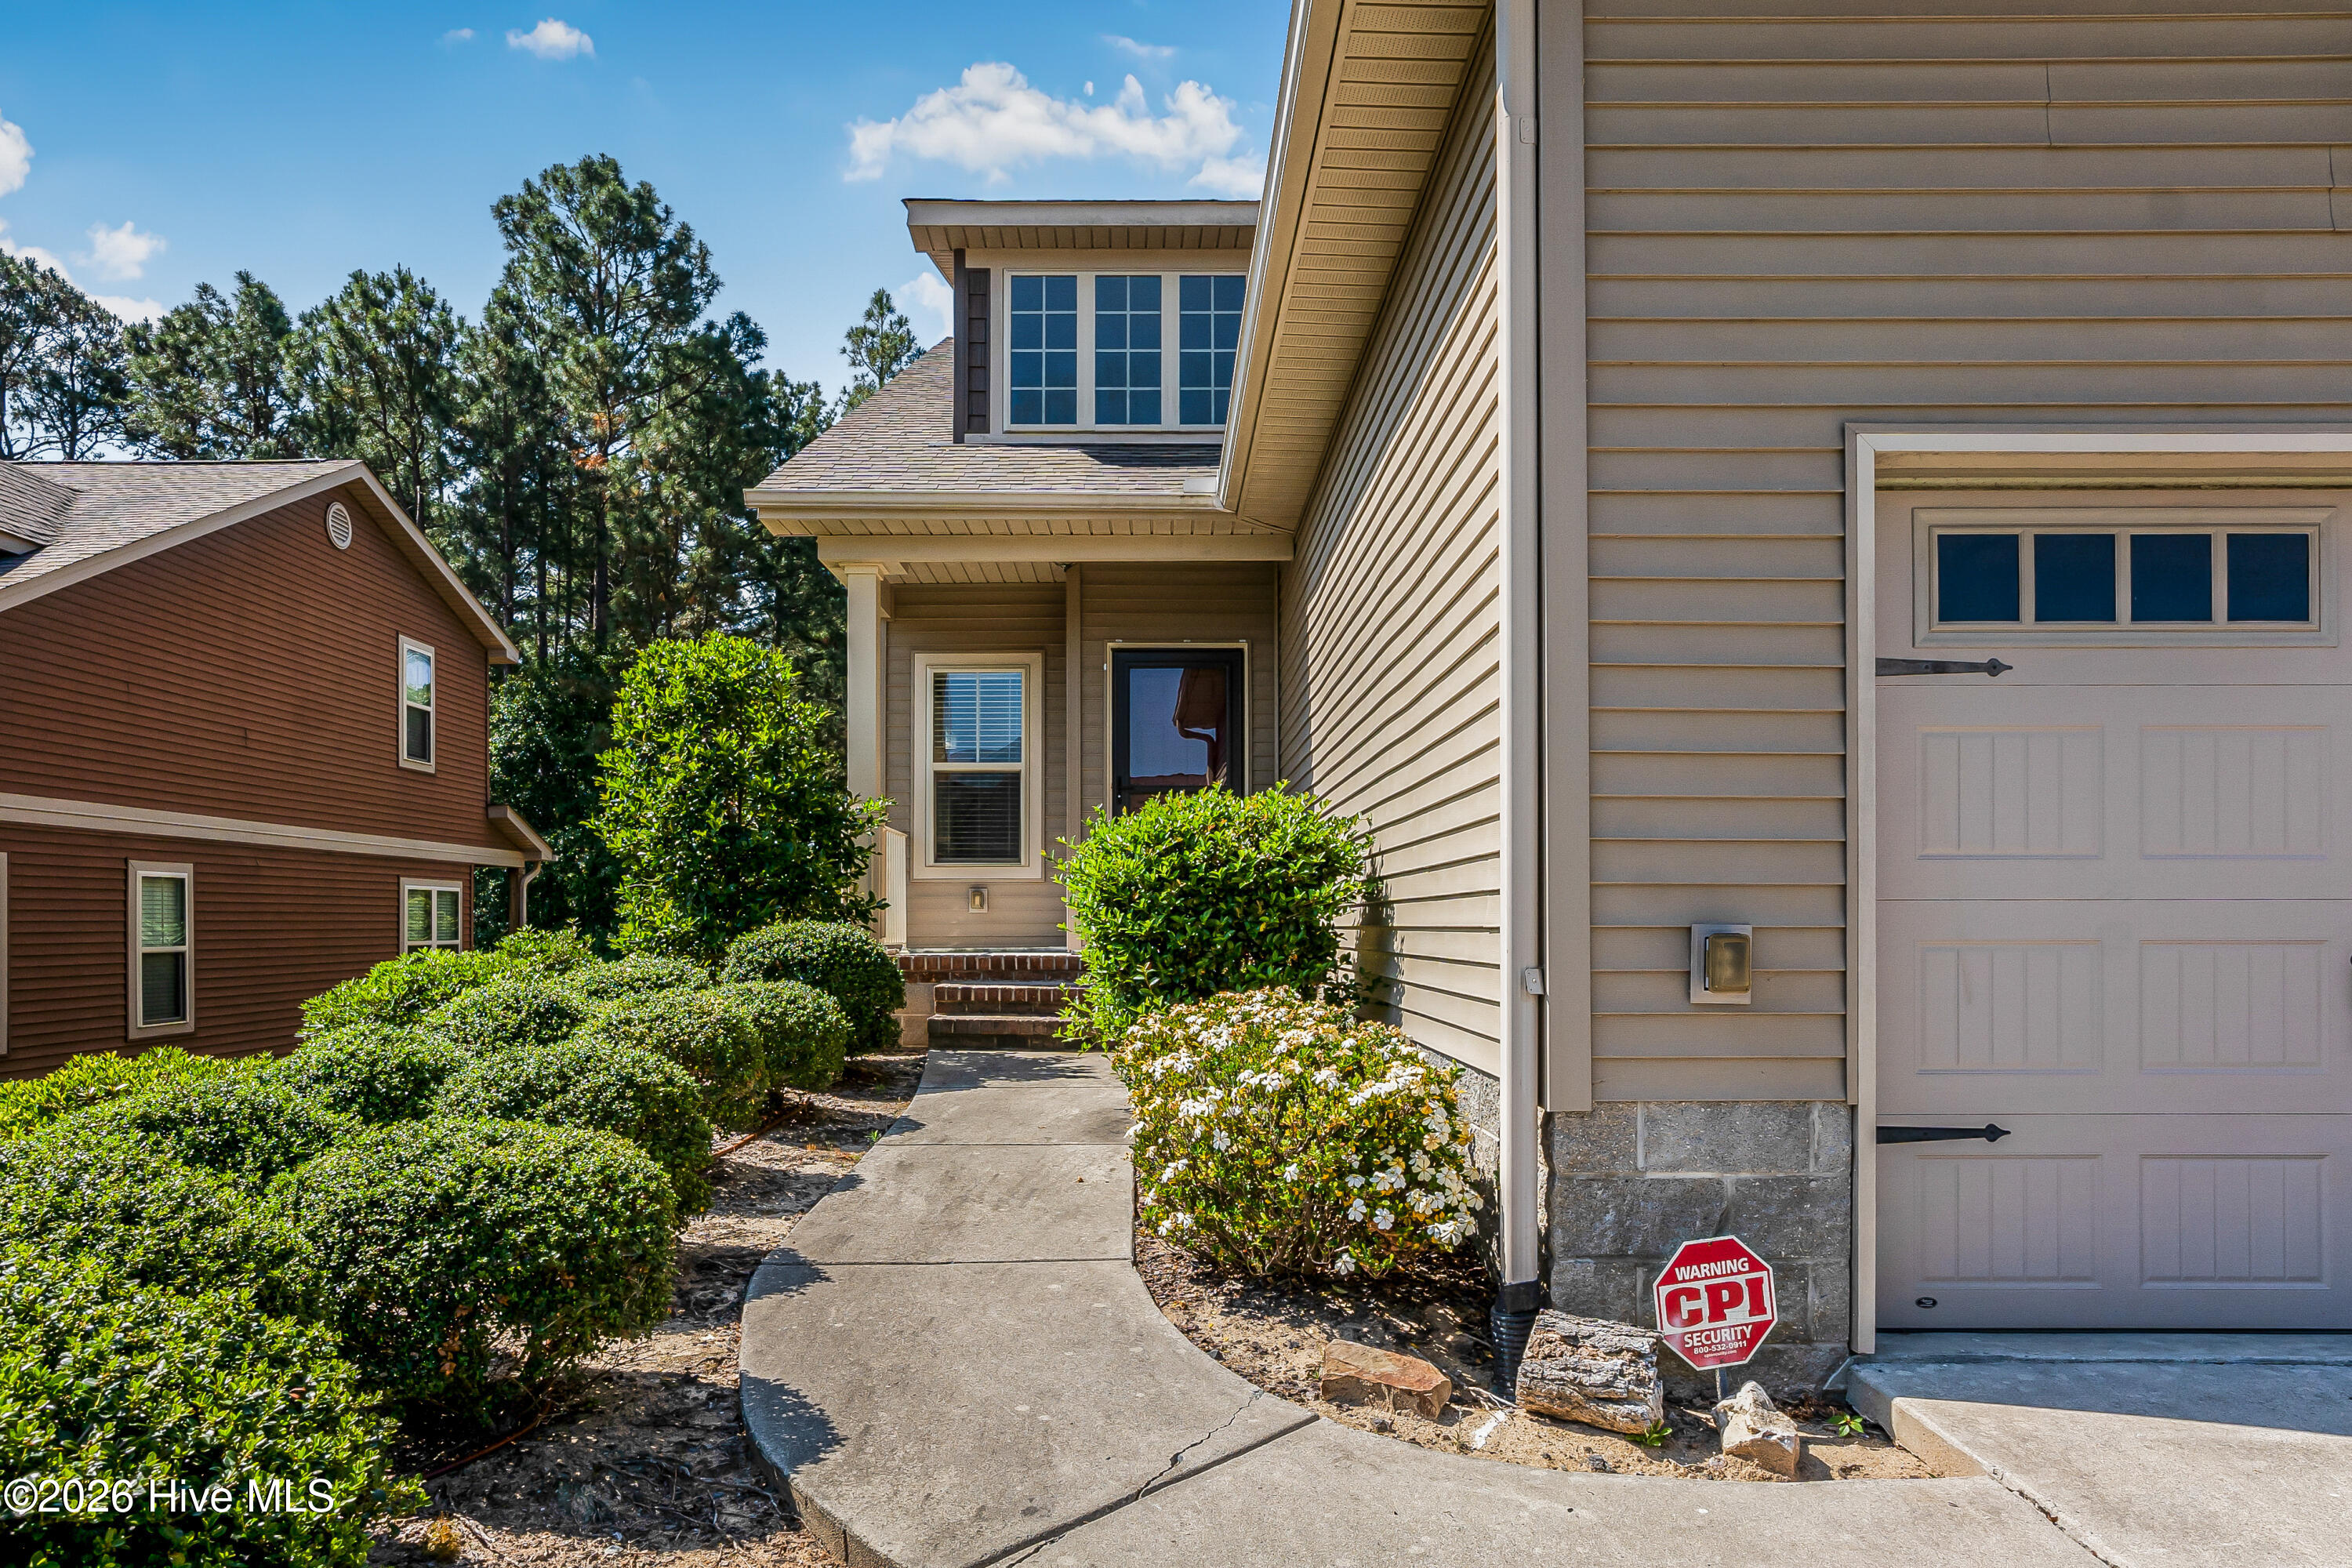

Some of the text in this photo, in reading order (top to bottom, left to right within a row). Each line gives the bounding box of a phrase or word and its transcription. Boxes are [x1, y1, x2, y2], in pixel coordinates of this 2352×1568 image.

[1675, 1258, 1749, 1281] WARNING
[1665, 1277, 1767, 1327] CPI
[1684, 1325, 1753, 1348] SECURITY
[1693, 1340, 1747, 1355] 800-532-0911
